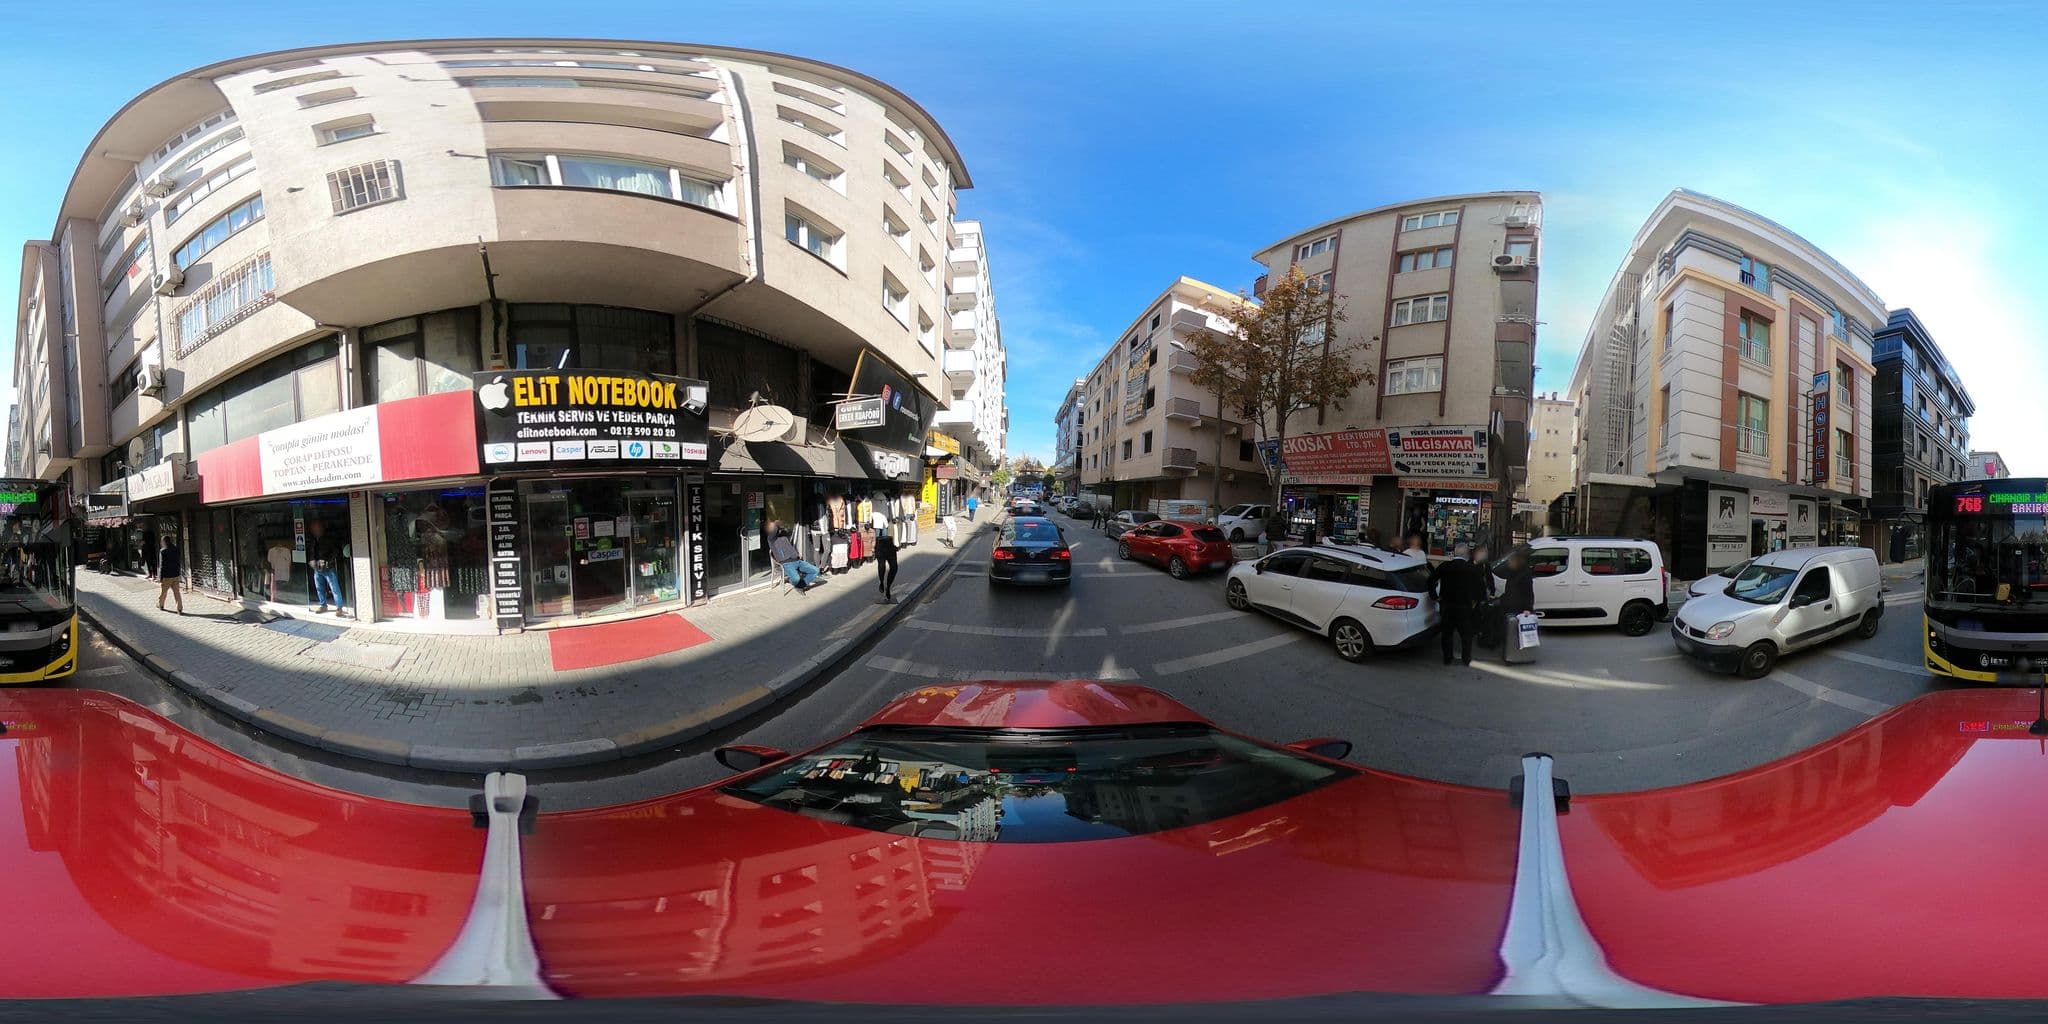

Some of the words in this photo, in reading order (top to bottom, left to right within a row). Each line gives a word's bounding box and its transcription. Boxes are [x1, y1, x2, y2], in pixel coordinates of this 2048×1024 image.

[568, 376, 677, 410] NOTEBOOK
[596, 410, 610, 422] VE
[612, 410, 644, 423] YEDEK
[646, 412, 676, 428] PARÇA
[516, 426, 598, 438] elitnotebook.com
[610, 426, 632, 436] 0212
[634, 426, 651, 436] 590
[652, 427, 664, 437] 20
[665, 428, 676, 438] 20
[1816, 396, 1826, 477] HOTEL
[1404, 438, 1472, 450] BİLGİSAYAR
[284, 453, 313, 468] ÇORAP
[314, 445, 353, 460] DEPOSU
[522, 448, 548, 456] Lenovo
[556, 446, 583, 456] Casper
[684, 447, 706, 456] TOSHIBA
[273, 465, 306, 478] TOPTAN
[313, 454, 374, 472] PERAKENDE
[1436, 496, 1478, 504] NOTEBOOK
[1957, 497, 1982, 512] 76B
[590, 550, 621, 560] Casper
